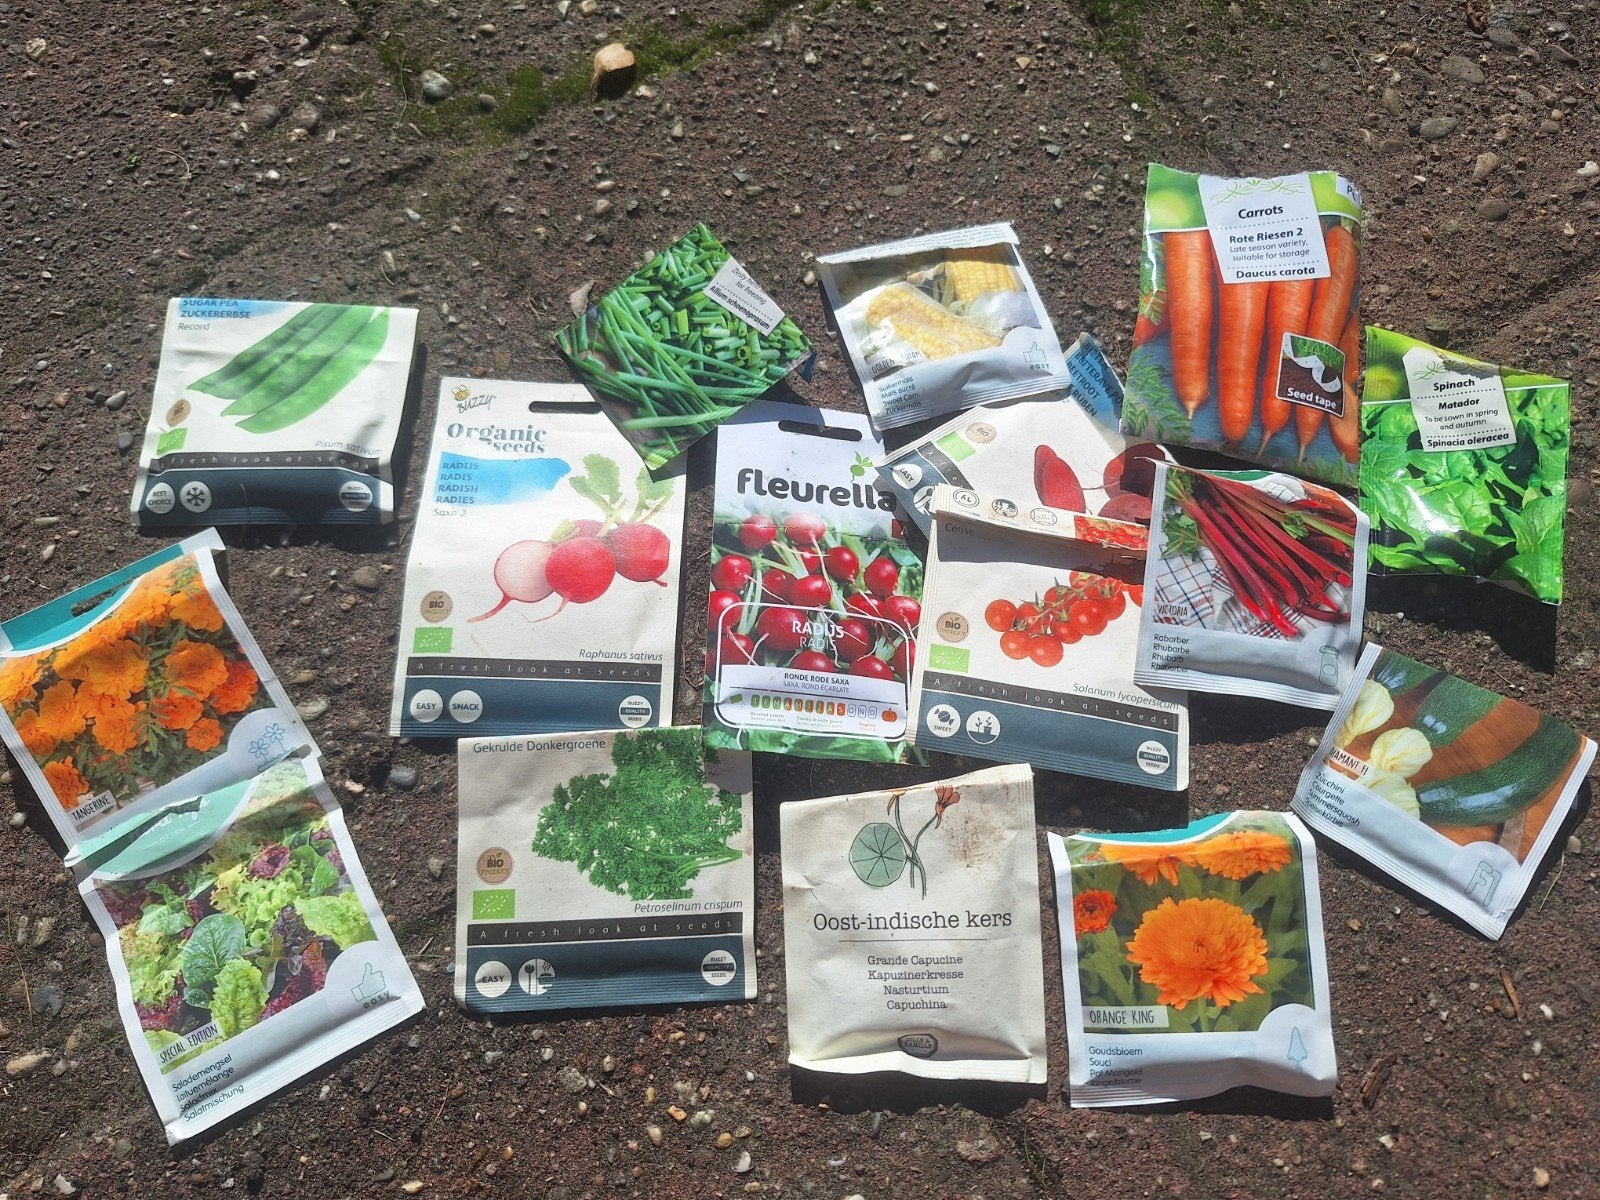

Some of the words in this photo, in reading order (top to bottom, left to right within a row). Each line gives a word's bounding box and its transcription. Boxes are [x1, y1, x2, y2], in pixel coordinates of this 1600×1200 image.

[1238, 205, 1284, 220] Carrots
[1229, 234, 1254, 244] Rote
[1257, 230, 1294, 242] Riesen
[1297, 228, 1303, 236] 2
[1229, 245, 1247, 253] Late
[1248, 243, 1276, 252] season
[1278, 239, 1309, 251] variety,
[1232, 252, 1264, 262] suitable
[1265, 252, 1277, 260] for
[1278, 249, 1310, 260] storage
[1236, 269, 1276, 279] Daucus
[1279, 266, 1315, 276] carota
[736, 281, 745, 290] for
[744, 286, 767, 305] freezing
[182, 299, 216, 307] SUGAR
[709, 285, 728, 301] Allium
[727, 298, 771, 329] schoenoprasum
[180, 310, 251, 319] ZUCKERERBSE
[177, 322, 210, 331] Record
[872, 358, 896, 374] GOLDEN
[1067, 361, 1100, 399] BEETROOT
[1075, 353, 1113, 396] BETTERAVE
[1433, 378, 1475, 392] Spinach
[457, 394, 494, 413] BUZZY
[1073, 390, 1098, 417] RÜBEN
[1287, 387, 1313, 401] Seed
[1315, 394, 1337, 409] tape
[1438, 399, 1480, 410] Matador
[1444, 413, 1465, 422] sown
[1474, 408, 1498, 418] spring
[1455, 419, 1487, 429] autumn
[447, 423, 547, 445] Organic
[1427, 439, 1465, 448] Spinacia
[1467, 432, 1509, 445] oleracea
[314, 440, 343, 448] Pisum
[493, 441, 545, 454] seeds
[171, 456, 217, 464] fresh
[442, 462, 479, 470] RADIJS
[900, 466, 914, 483] EASY
[152, 490, 167, 498] BEST
[438, 484, 478, 493] RADISH
[737, 468, 898, 513] fleurella
[149, 498, 173, 506] CHOICE
[436, 496, 475, 504] RADIES
[945, 523, 974, 536] Cerise
[429, 600, 444, 609] BIO
[1157, 604, 1188, 617] VICTORIA
[944, 621, 961, 630] BIO
[799, 637, 836, 651] RADIS
[1153, 633, 1190, 645] Rabarber
[578, 648, 628, 660] Raphanus
[630, 650, 663, 661] sativus
[1152, 643, 1190, 655] Rhubarbe
[1151, 652, 1184, 663] Rhubarb
[440, 662, 491, 672] fresh
[507, 664, 548, 674] look
[564, 667, 581, 675] at
[598, 668, 651, 677] seeds
[1150, 662, 1189, 673] Rhabarber
[784, 672, 809, 682] RONDE
[810, 675, 829, 684] RODE
[831, 677, 850, 686] SAXA
[801, 682, 820, 691] ROND
[934, 678, 941, 686] A
[957, 680, 1008, 696] fresh
[1024, 692, 1066, 706] look
[1082, 703, 1100, 712] at
[1115, 708, 1168, 726] seeds
[1073, 682, 1116, 698] Solanum
[1118, 690, 1179, 710] lycopersicum
[416, 702, 437, 710] EASY
[452, 702, 480, 711] SNACK
[933, 724, 951, 733] SWEET
[473, 742, 524, 754] Gekrulde
[526, 739, 606, 753] Donkergroene
[1315, 772, 1346, 794] Zucchini
[1312, 780, 1345, 806] Courgette
[71, 794, 111, 822] TANGERINE
[1308, 788, 1360, 826] Summersquash
[486, 859, 504, 868] BIO
[1463, 860, 1502, 907] F1
[634, 902, 701, 913] Petroselinum
[703, 900, 743, 912] crispum
[813, 912, 960, 931] Oost-indische
[965, 910, 1012, 928] kers
[480, 930, 487, 938] A
[504, 926, 560, 938] fresh
[578, 924, 621, 935] look
[640, 923, 658, 932] at
[676, 920, 731, 931] seeds
[867, 955, 908, 965] Grande
[910, 955, 963, 967] Capucine
[482, 974, 505, 984] EASY
[867, 970, 964, 980] Kapuzinerkresse
[883, 985, 949, 994] Nasturtium
[363, 990, 391, 1010] easy
[886, 1000, 947, 1011] Capuchina
[1089, 1010, 1128, 1025] ORANGE
[1131, 1010, 1155, 1024] KING
[159, 1040, 186, 1064] SPECIAL
[188, 1023, 218, 1049] EDITION
[1088, 1046, 1143, 1056] Goudsbloem
[1089, 1057, 1112, 1066] Souci
[172, 1054, 232, 1093] Salademengsel
[1090, 1068, 1103, 1078] Pot
[1105, 1068, 1143, 1077] Marigold
[180, 1088, 219, 1113] Saladmix
[184, 1083, 244, 1123] Salatmischung
